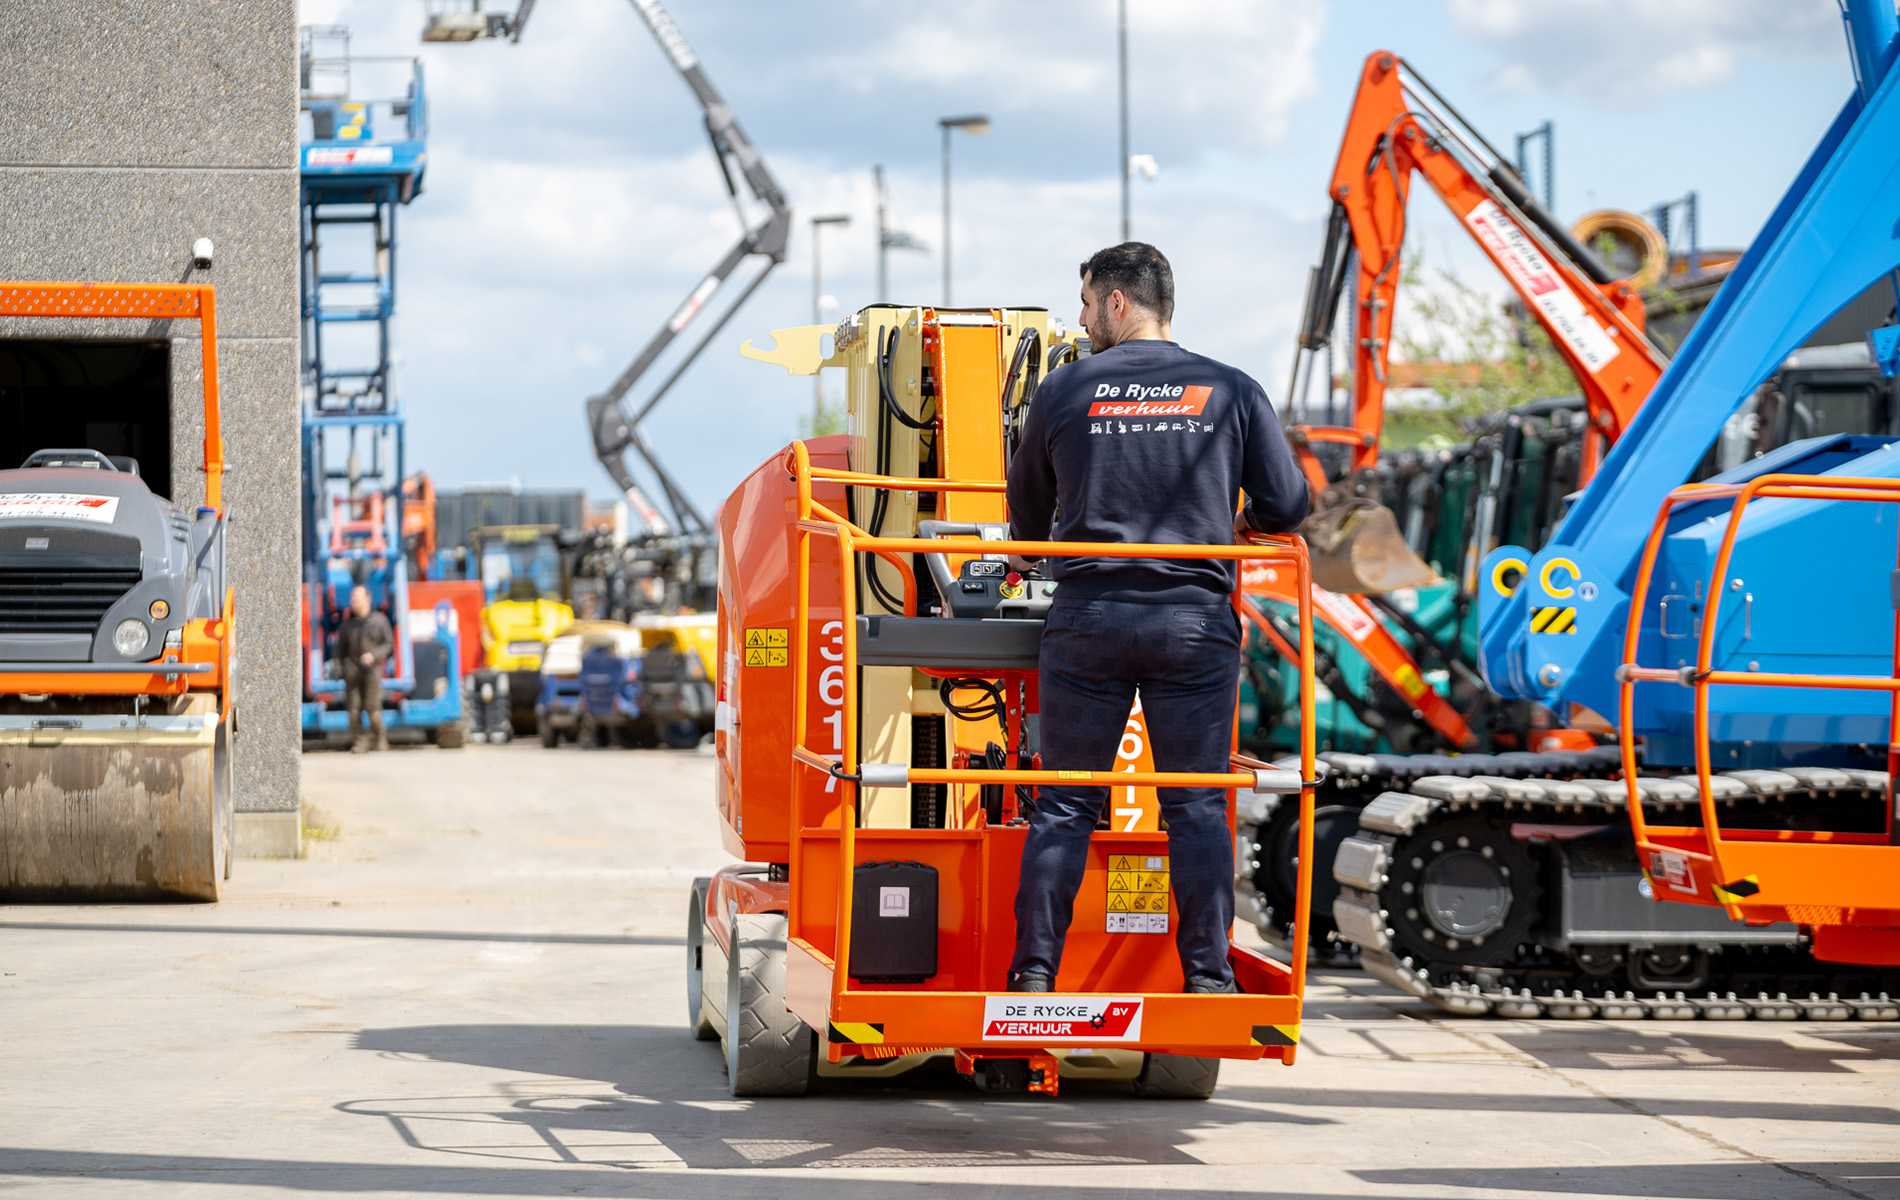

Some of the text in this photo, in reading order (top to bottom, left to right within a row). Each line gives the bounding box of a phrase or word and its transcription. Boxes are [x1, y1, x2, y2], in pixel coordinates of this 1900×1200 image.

[1095, 384, 1183, 401] De Rycke
[1099, 401, 1194, 415] verhuur
[1005, 1006, 1088, 1017] DE RYCKE
[1112, 1007, 1129, 1017] BV
[995, 1023, 1072, 1035] VERHUUR
